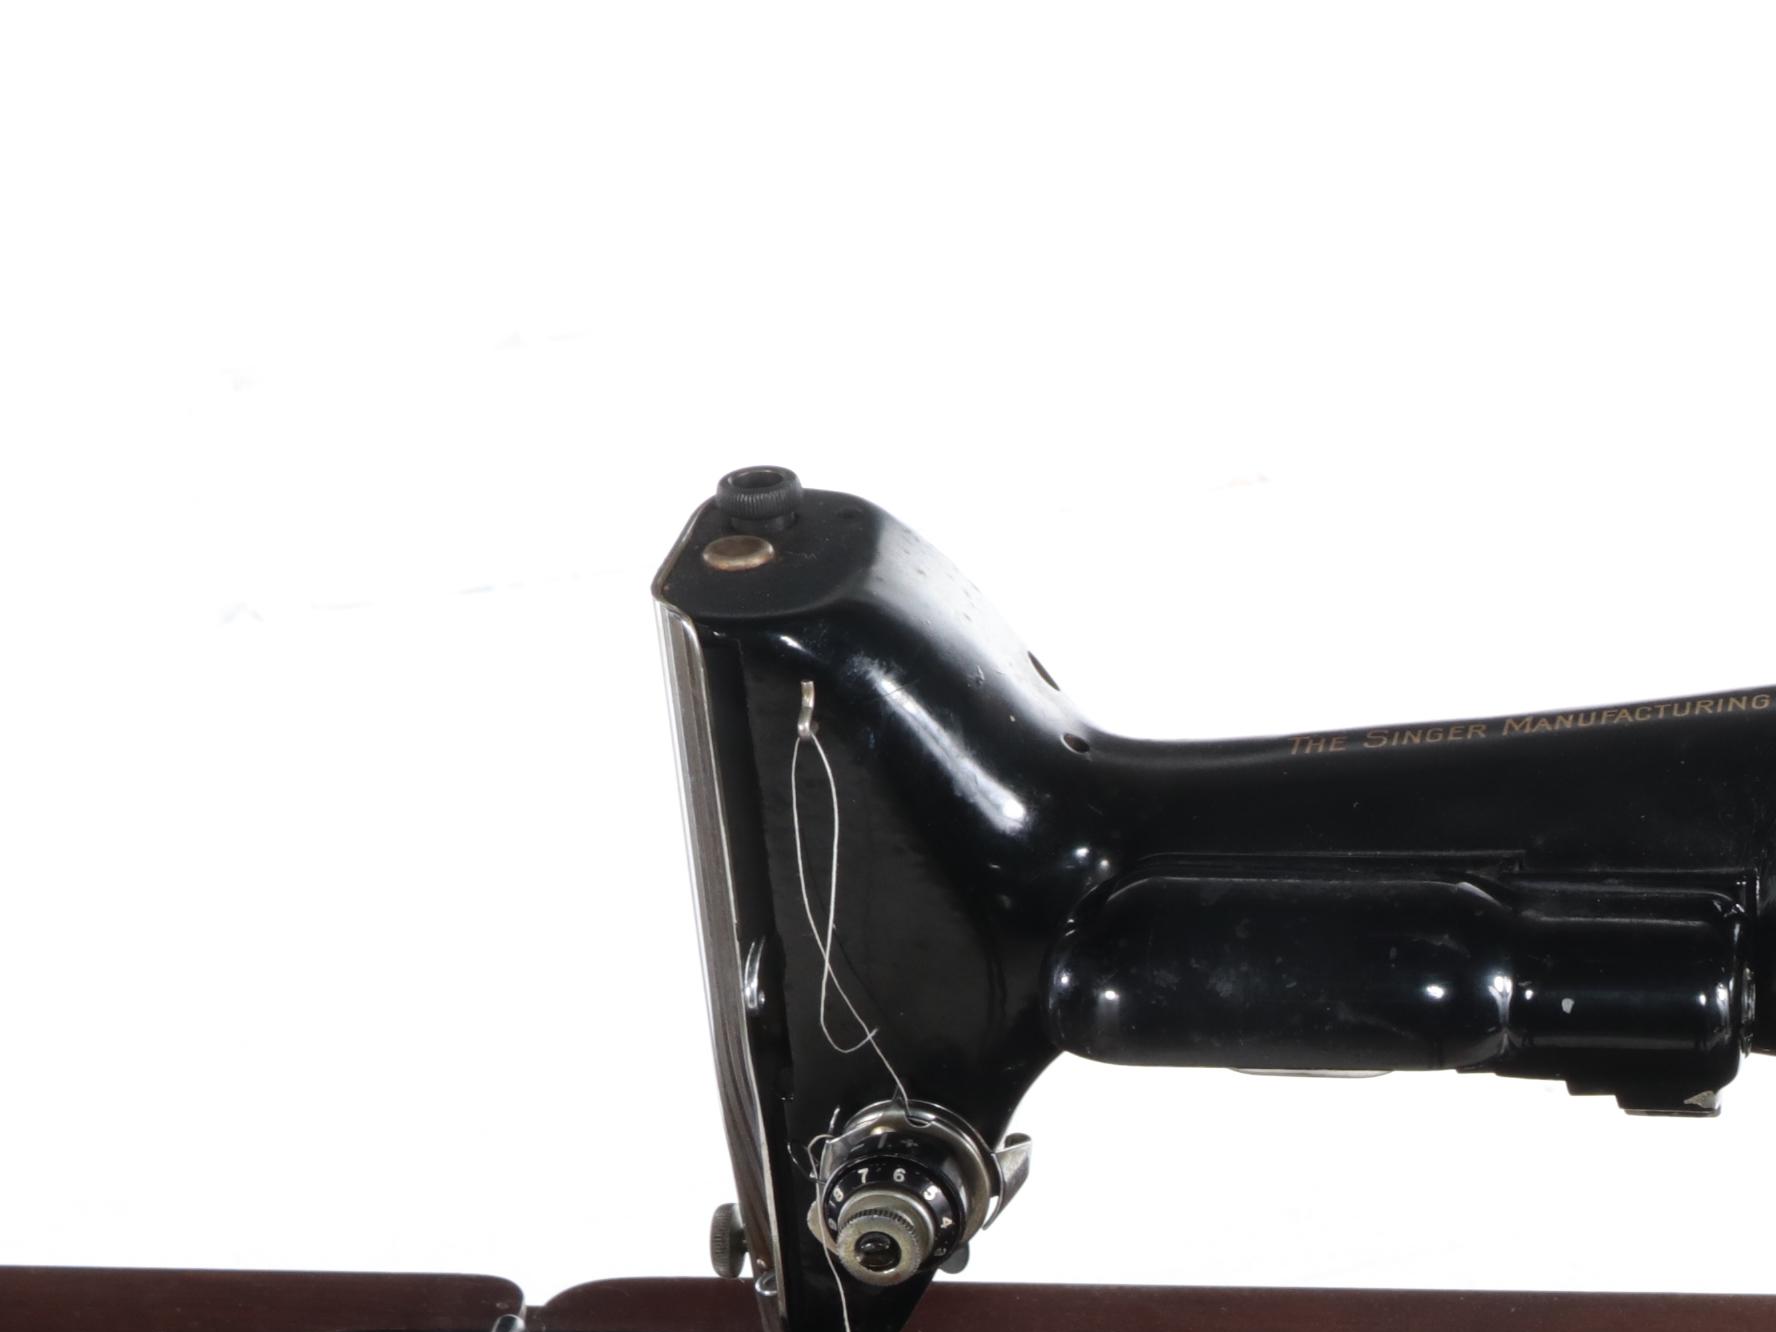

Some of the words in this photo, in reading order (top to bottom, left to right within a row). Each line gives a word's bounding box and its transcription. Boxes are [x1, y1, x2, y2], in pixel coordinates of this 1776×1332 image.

[1289, 735, 1347, 755] THE
[1363, 724, 1487, 748] SINGER
[1502, 694, 1770, 736] MANUFACTURING
[857, 1168, 869, 1185] 7
[893, 1168, 906, 1183] 6
[940, 1216, 953, 1229] 4
